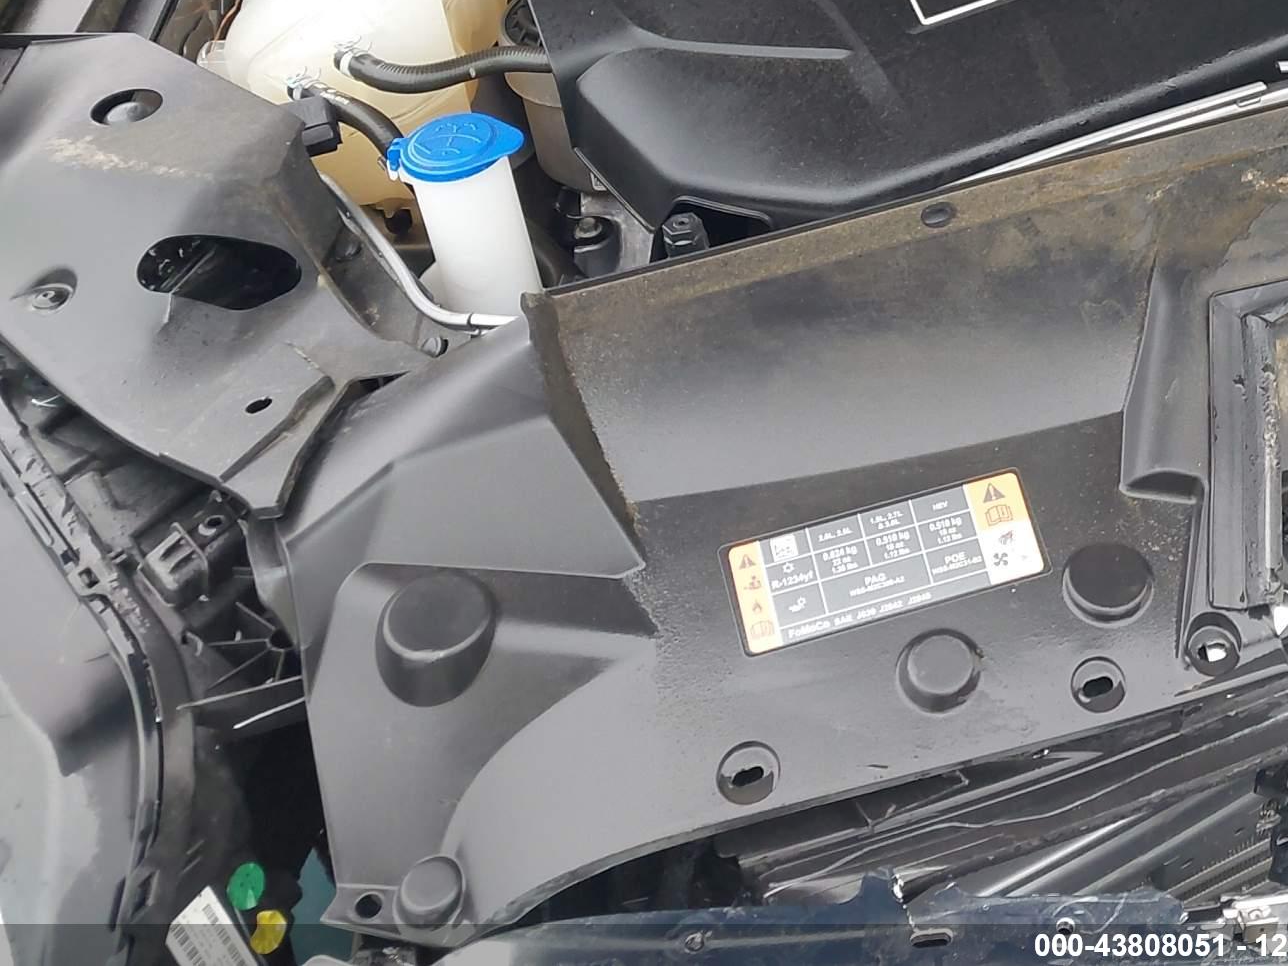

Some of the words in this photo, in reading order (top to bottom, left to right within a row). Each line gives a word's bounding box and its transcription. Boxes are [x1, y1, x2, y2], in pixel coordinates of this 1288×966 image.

[951, 516, 962, 526] kg
[898, 530, 910, 541] kg
[845, 545, 857, 557] kg
[945, 552, 967, 564] POE
[771, 569, 814, 589] R-1234yf
[864, 572, 886, 585] PAG
[788, 620, 830, 638] FoMoCo
